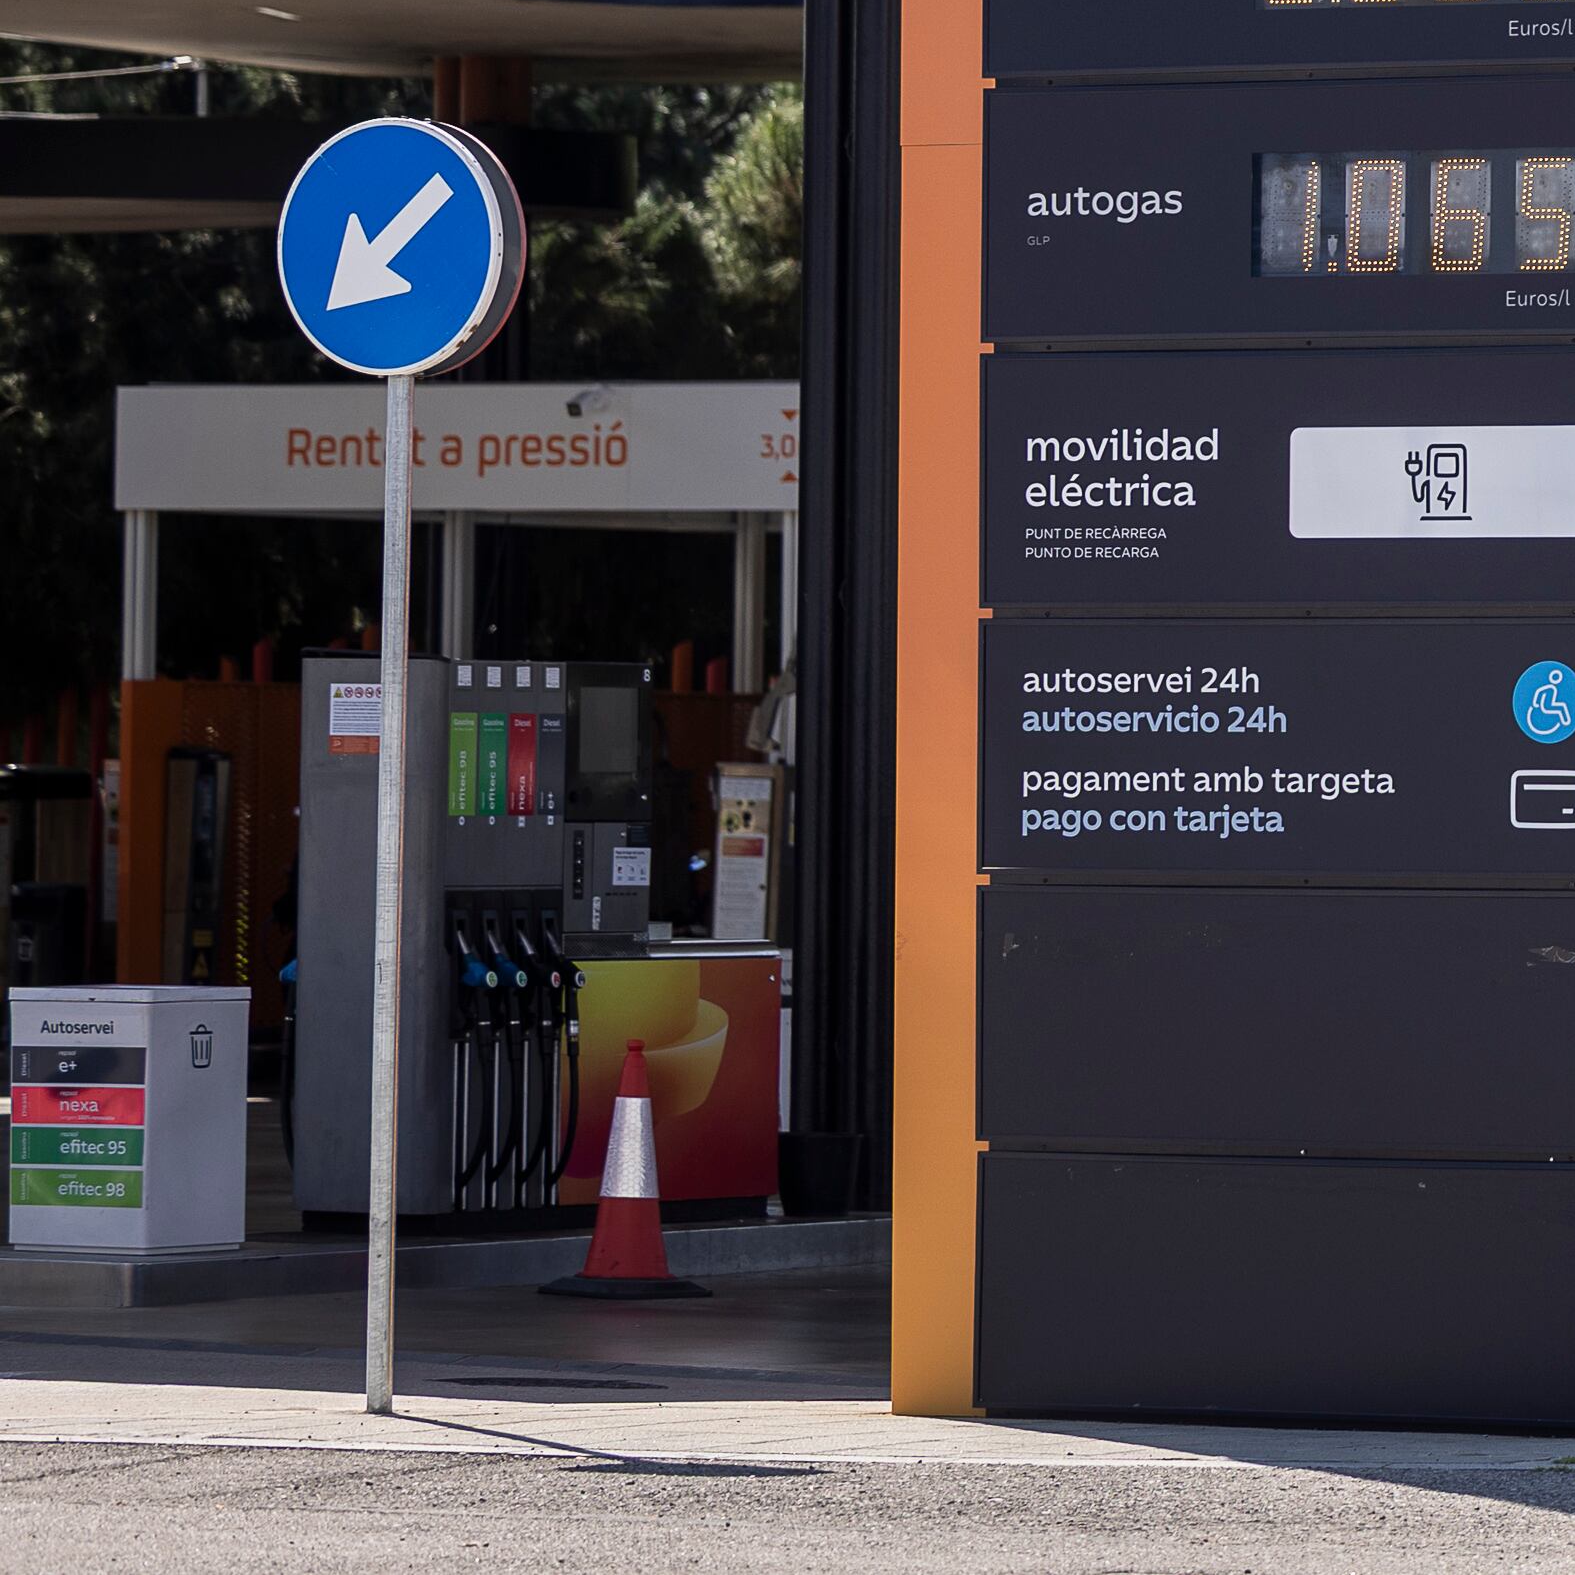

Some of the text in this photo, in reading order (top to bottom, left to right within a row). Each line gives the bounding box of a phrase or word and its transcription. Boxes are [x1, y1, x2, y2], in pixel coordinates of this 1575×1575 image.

[1508, 18, 1574, 37] Euros/l
[1027, 186, 1183, 224] autogas
[1301, 155, 1574, 273] 1.065
[1026, 235, 1051, 246] GLP
[1505, 288, 1571, 307] Euros/l
[286, 420, 629, 477] Rentt a pressió
[759, 434, 797, 461] 3,0
[1026, 427, 1219, 462] movilidad
[1025, 473, 1197, 508] eléctrica
[1025, 524, 1167, 540] PUNT DE RECÀRREGA
[1025, 546, 1160, 559] PUNTO DE RECARGA
[1023, 665, 1260, 694] autoservei 24h
[1022, 704, 1287, 733] autoservicio 24h
[1022, 765, 1396, 801] pagament amb targeta
[1021, 803, 1285, 839] pago con tarjeta
[40, 1020, 114, 1035] Autoservei
[58, 1060, 77, 1073] e+
[59, 1099, 99, 1112] nexa
[59, 1139, 127, 1155] efitec 95
[58, 1181, 126, 1197] efitec 98
